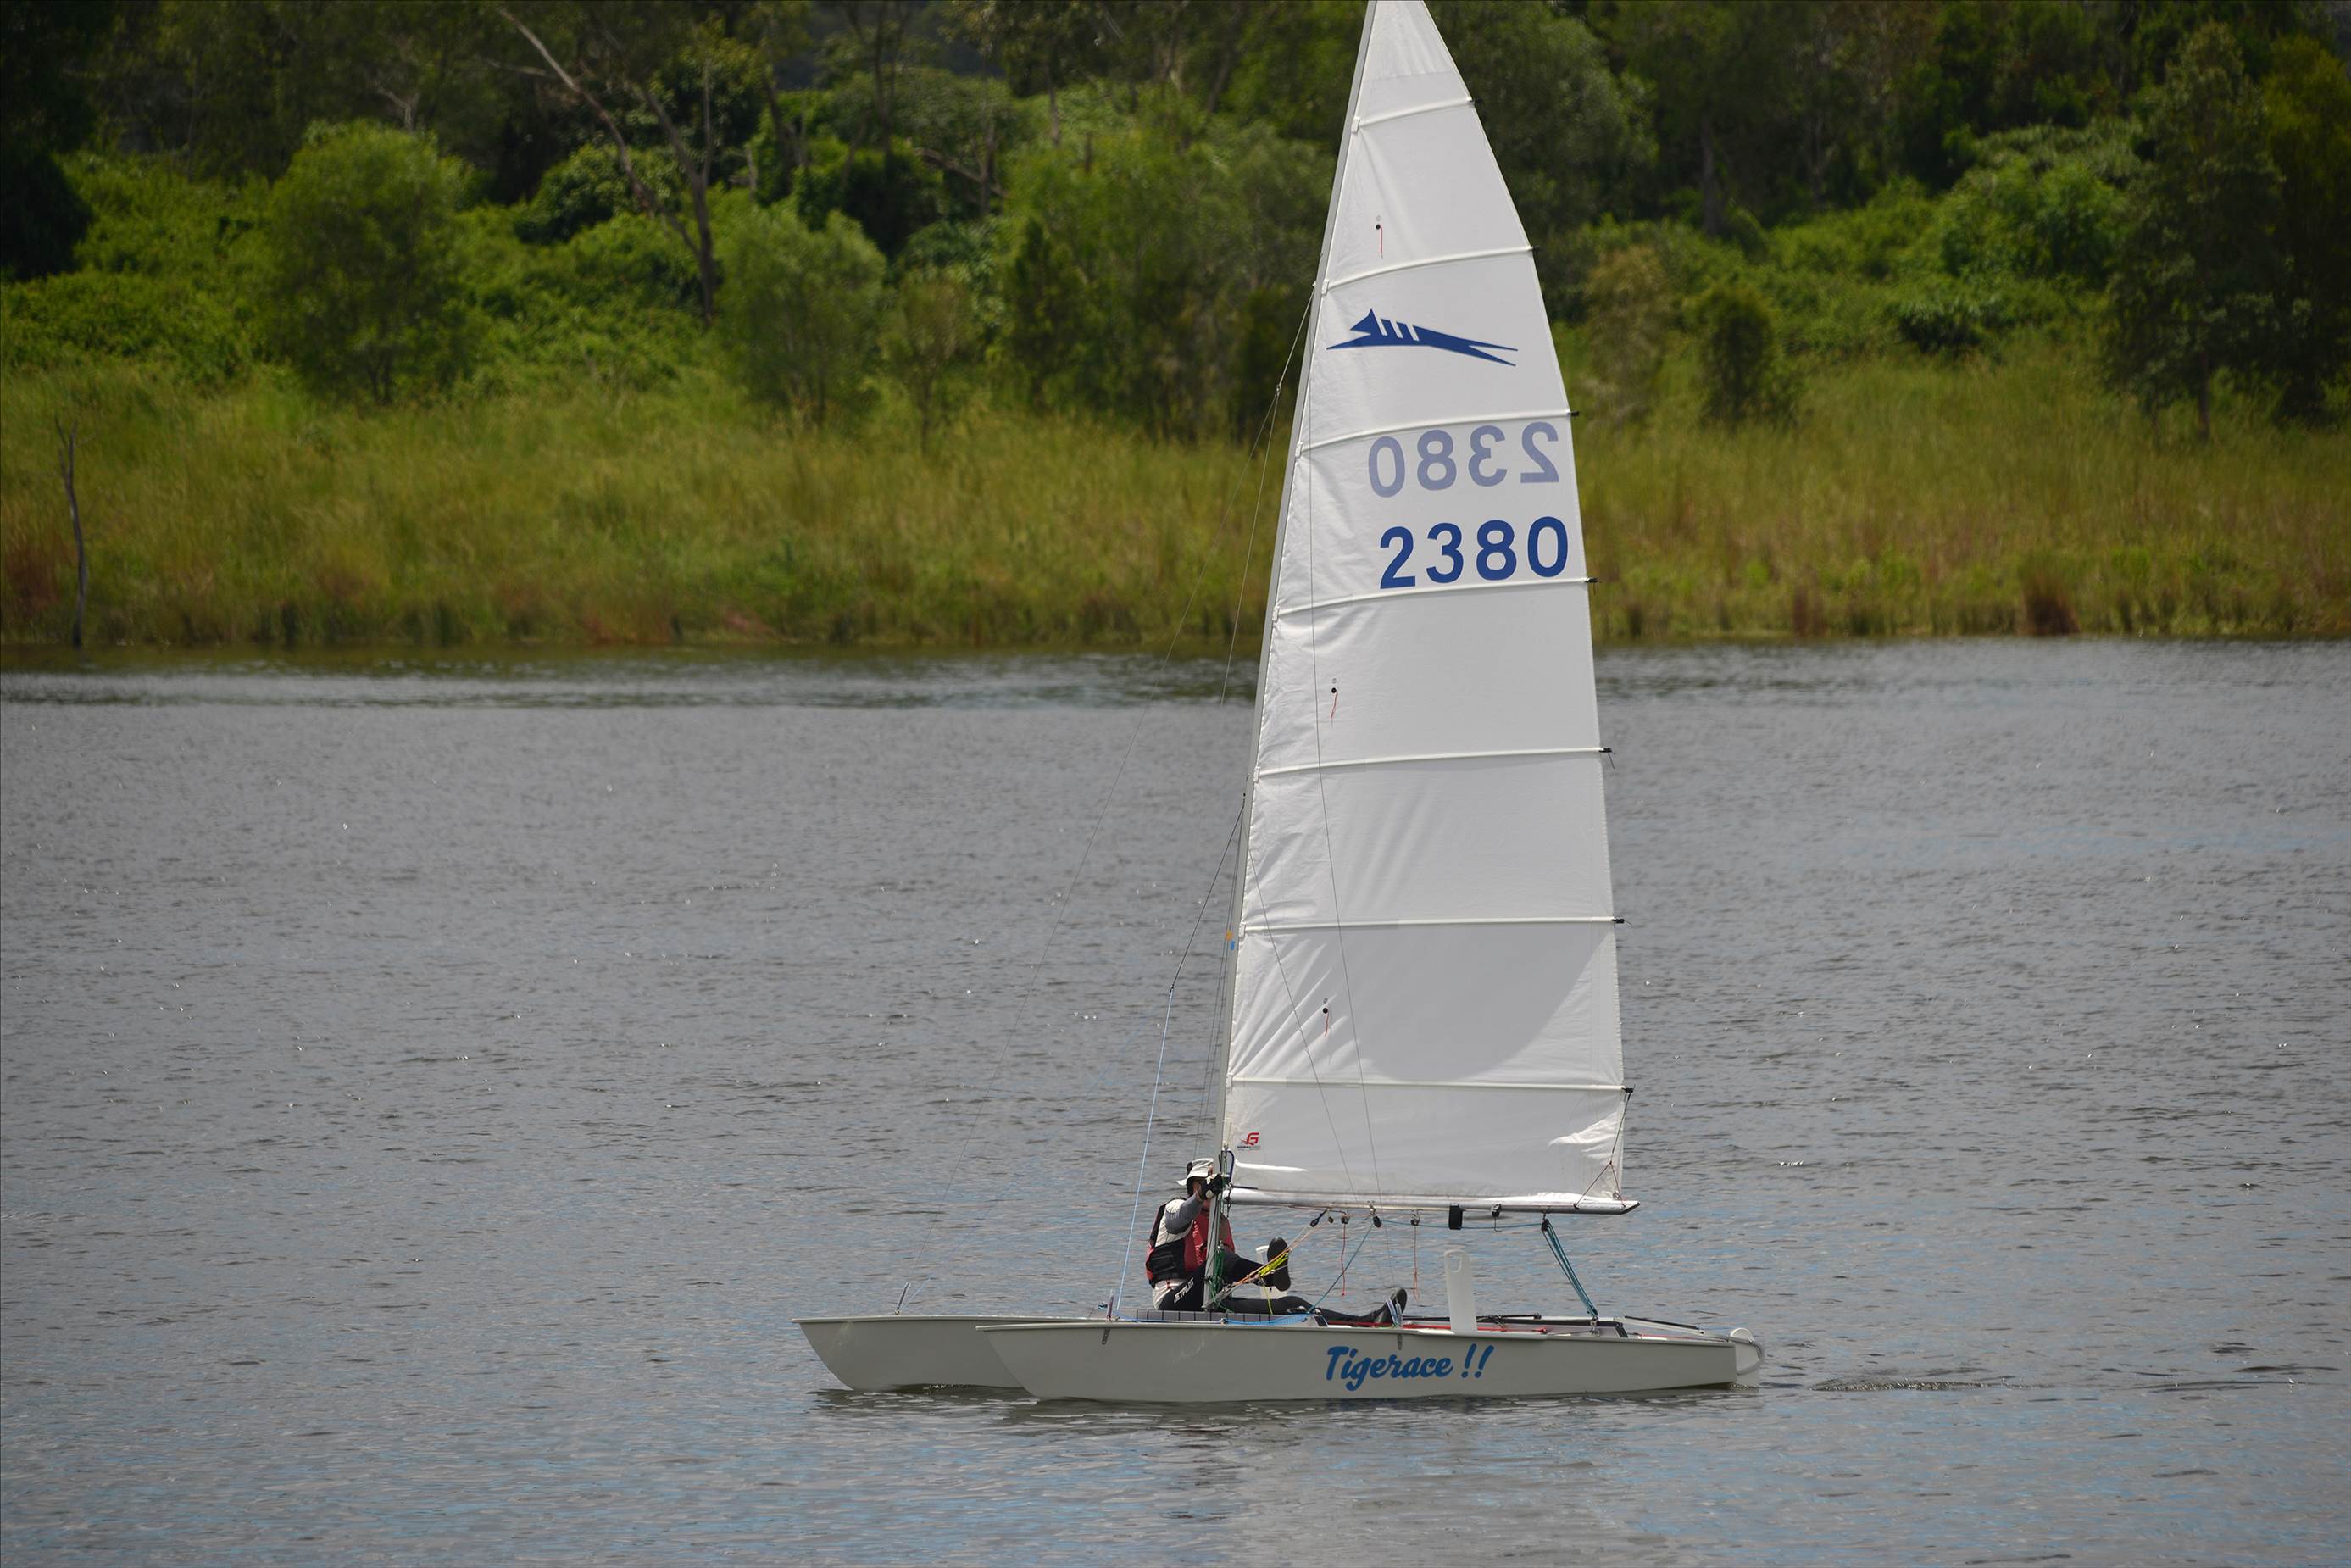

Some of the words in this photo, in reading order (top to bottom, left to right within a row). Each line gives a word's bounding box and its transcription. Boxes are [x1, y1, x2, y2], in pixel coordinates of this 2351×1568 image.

[1380, 516, 1568, 589] 2380
[1326, 1346, 1453, 1391] Tigerace
[1461, 1343, 1494, 1378] !!
